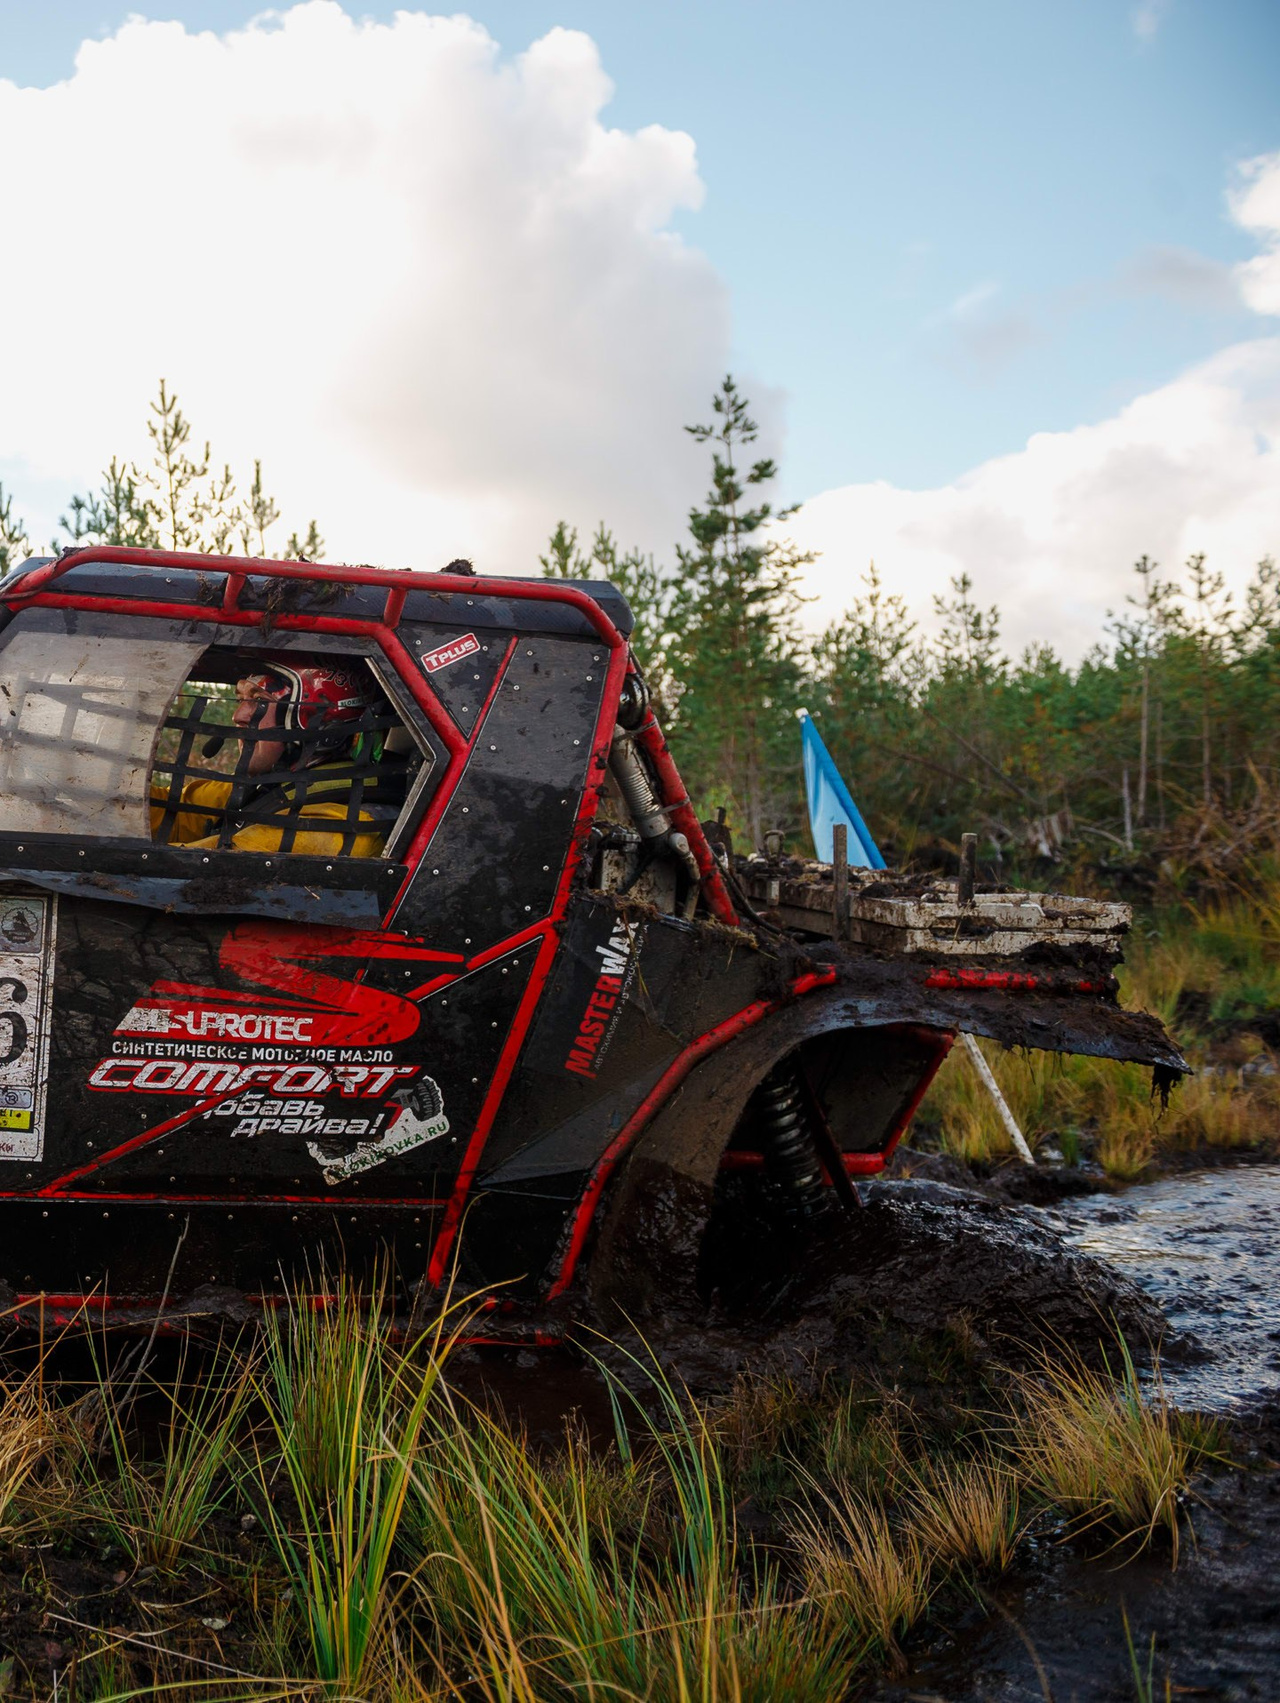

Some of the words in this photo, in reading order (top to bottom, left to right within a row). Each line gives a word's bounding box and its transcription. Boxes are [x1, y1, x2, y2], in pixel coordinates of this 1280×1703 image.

[425, 640, 476, 667] TPLUS
[339, 1051, 393, 1063] МАСЛО
[87, 1058, 415, 1095] COMFORT
